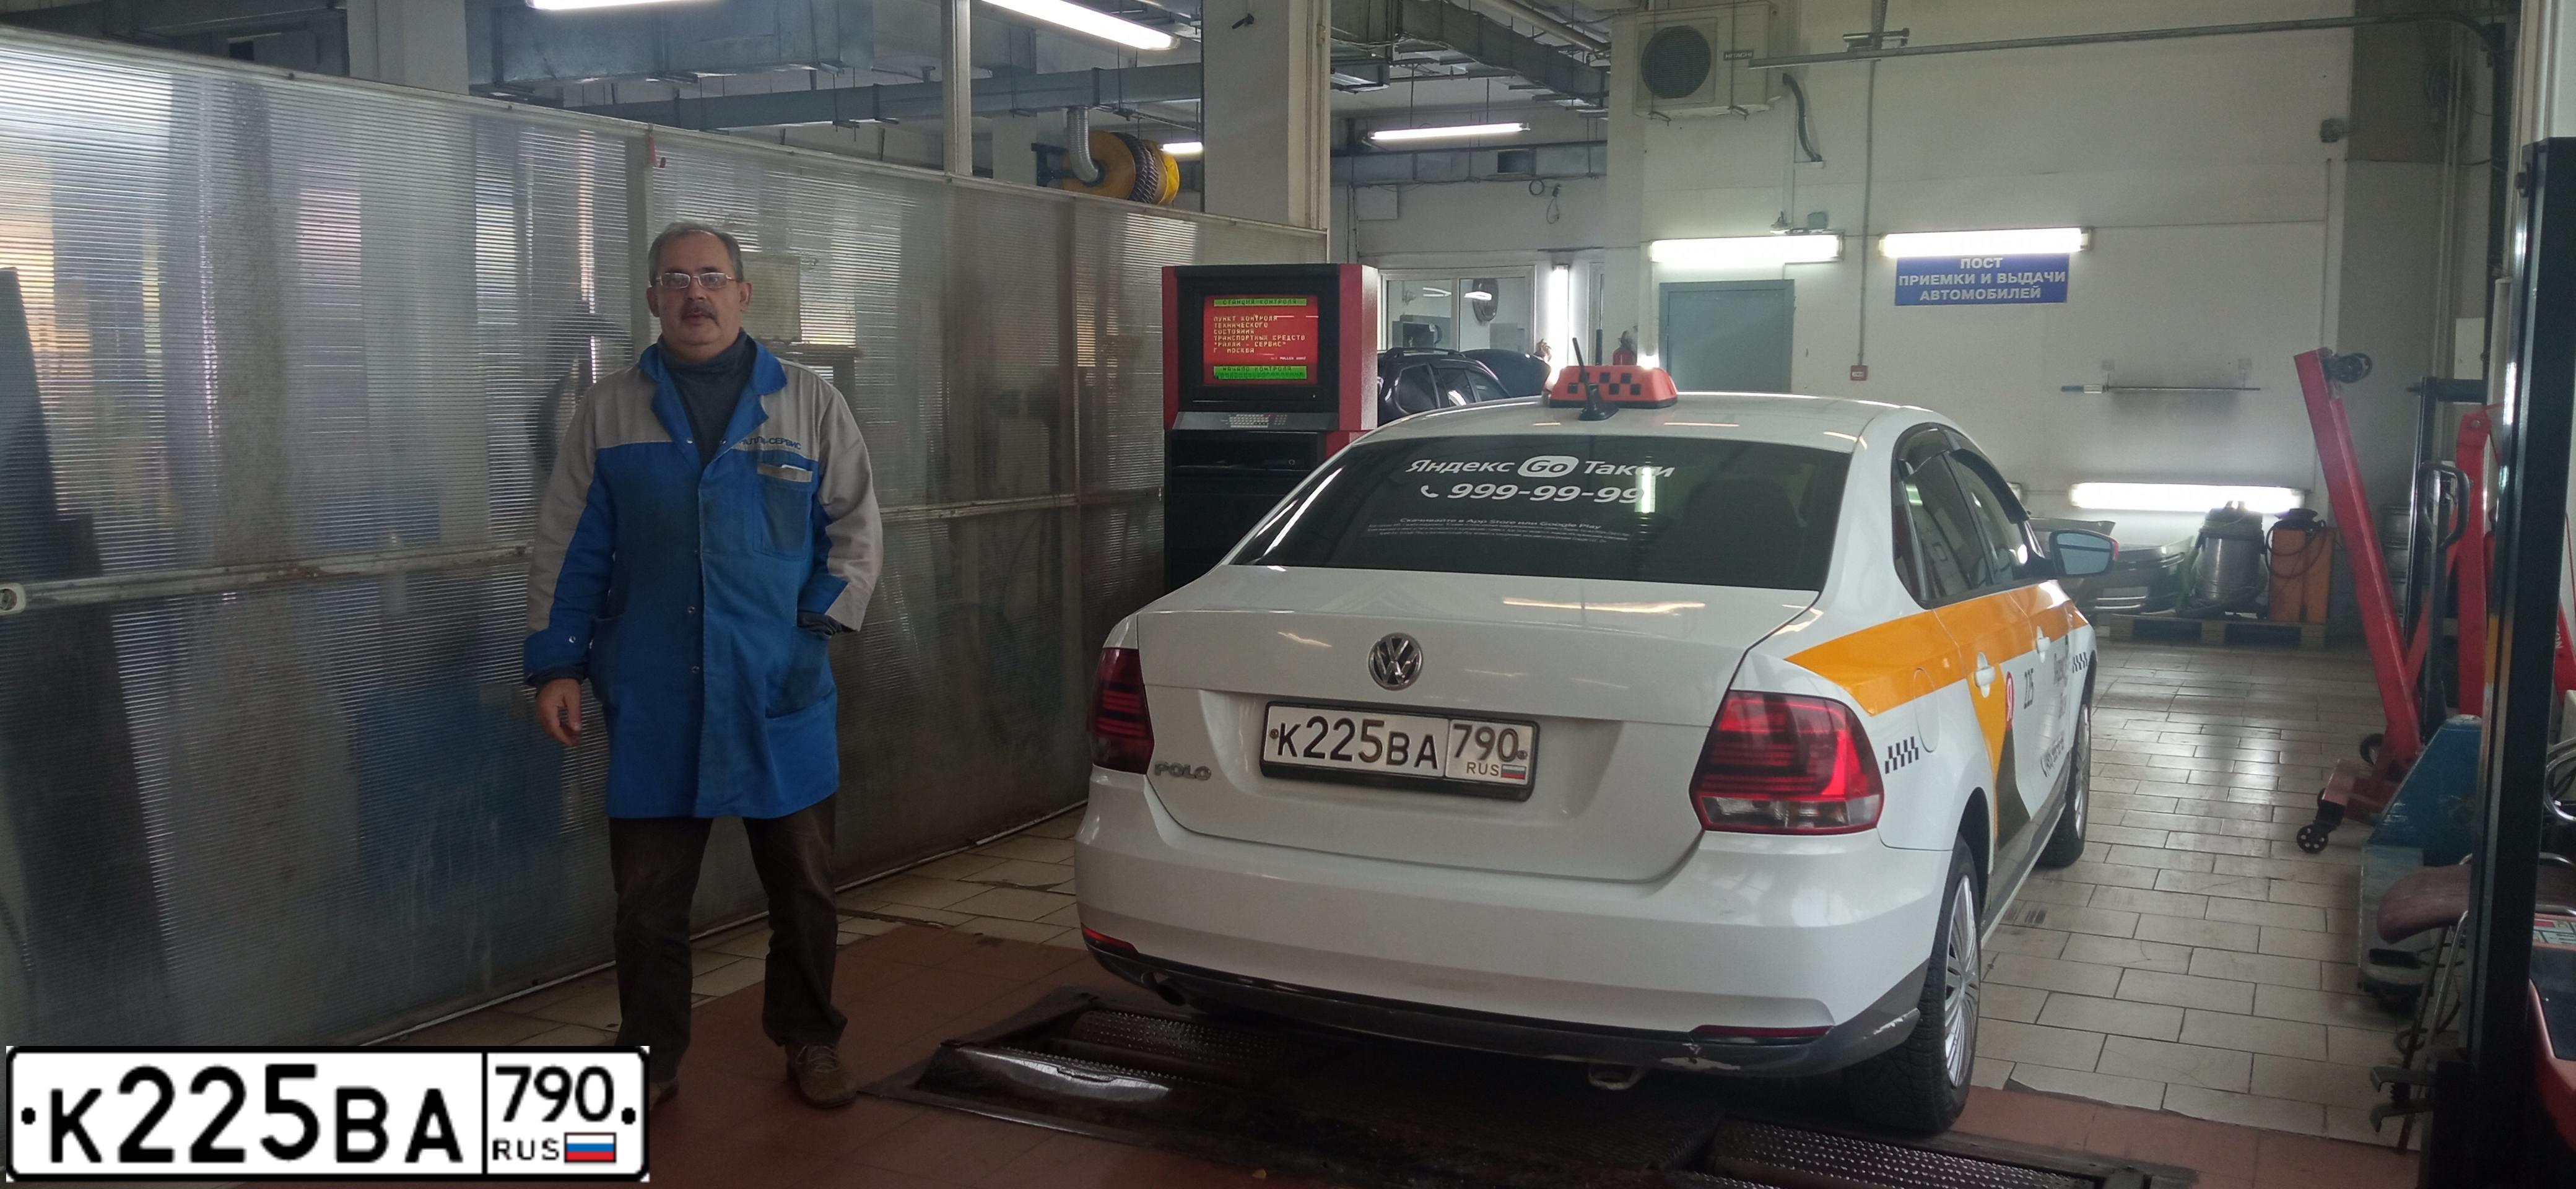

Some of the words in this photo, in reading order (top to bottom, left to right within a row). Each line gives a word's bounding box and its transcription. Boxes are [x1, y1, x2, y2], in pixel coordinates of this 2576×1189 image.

[1960, 257, 2003, 269] ПОСТ
[1899, 274, 1975, 286] ПРИЕМКИ
[1981, 273, 1991, 284] И
[1996, 271, 2066, 285] ВЫДАЧИ
[1920, 285, 2042, 301] АВТОМОБИЛЕЙ
[1405, 459, 1515, 474] Яндекс
[1447, 483, 1645, 503] 999-99-99
[1452, 723, 1518, 763] 790
[1154, 762, 1212, 781] POLO
[1466, 761, 1500, 777] RUS
